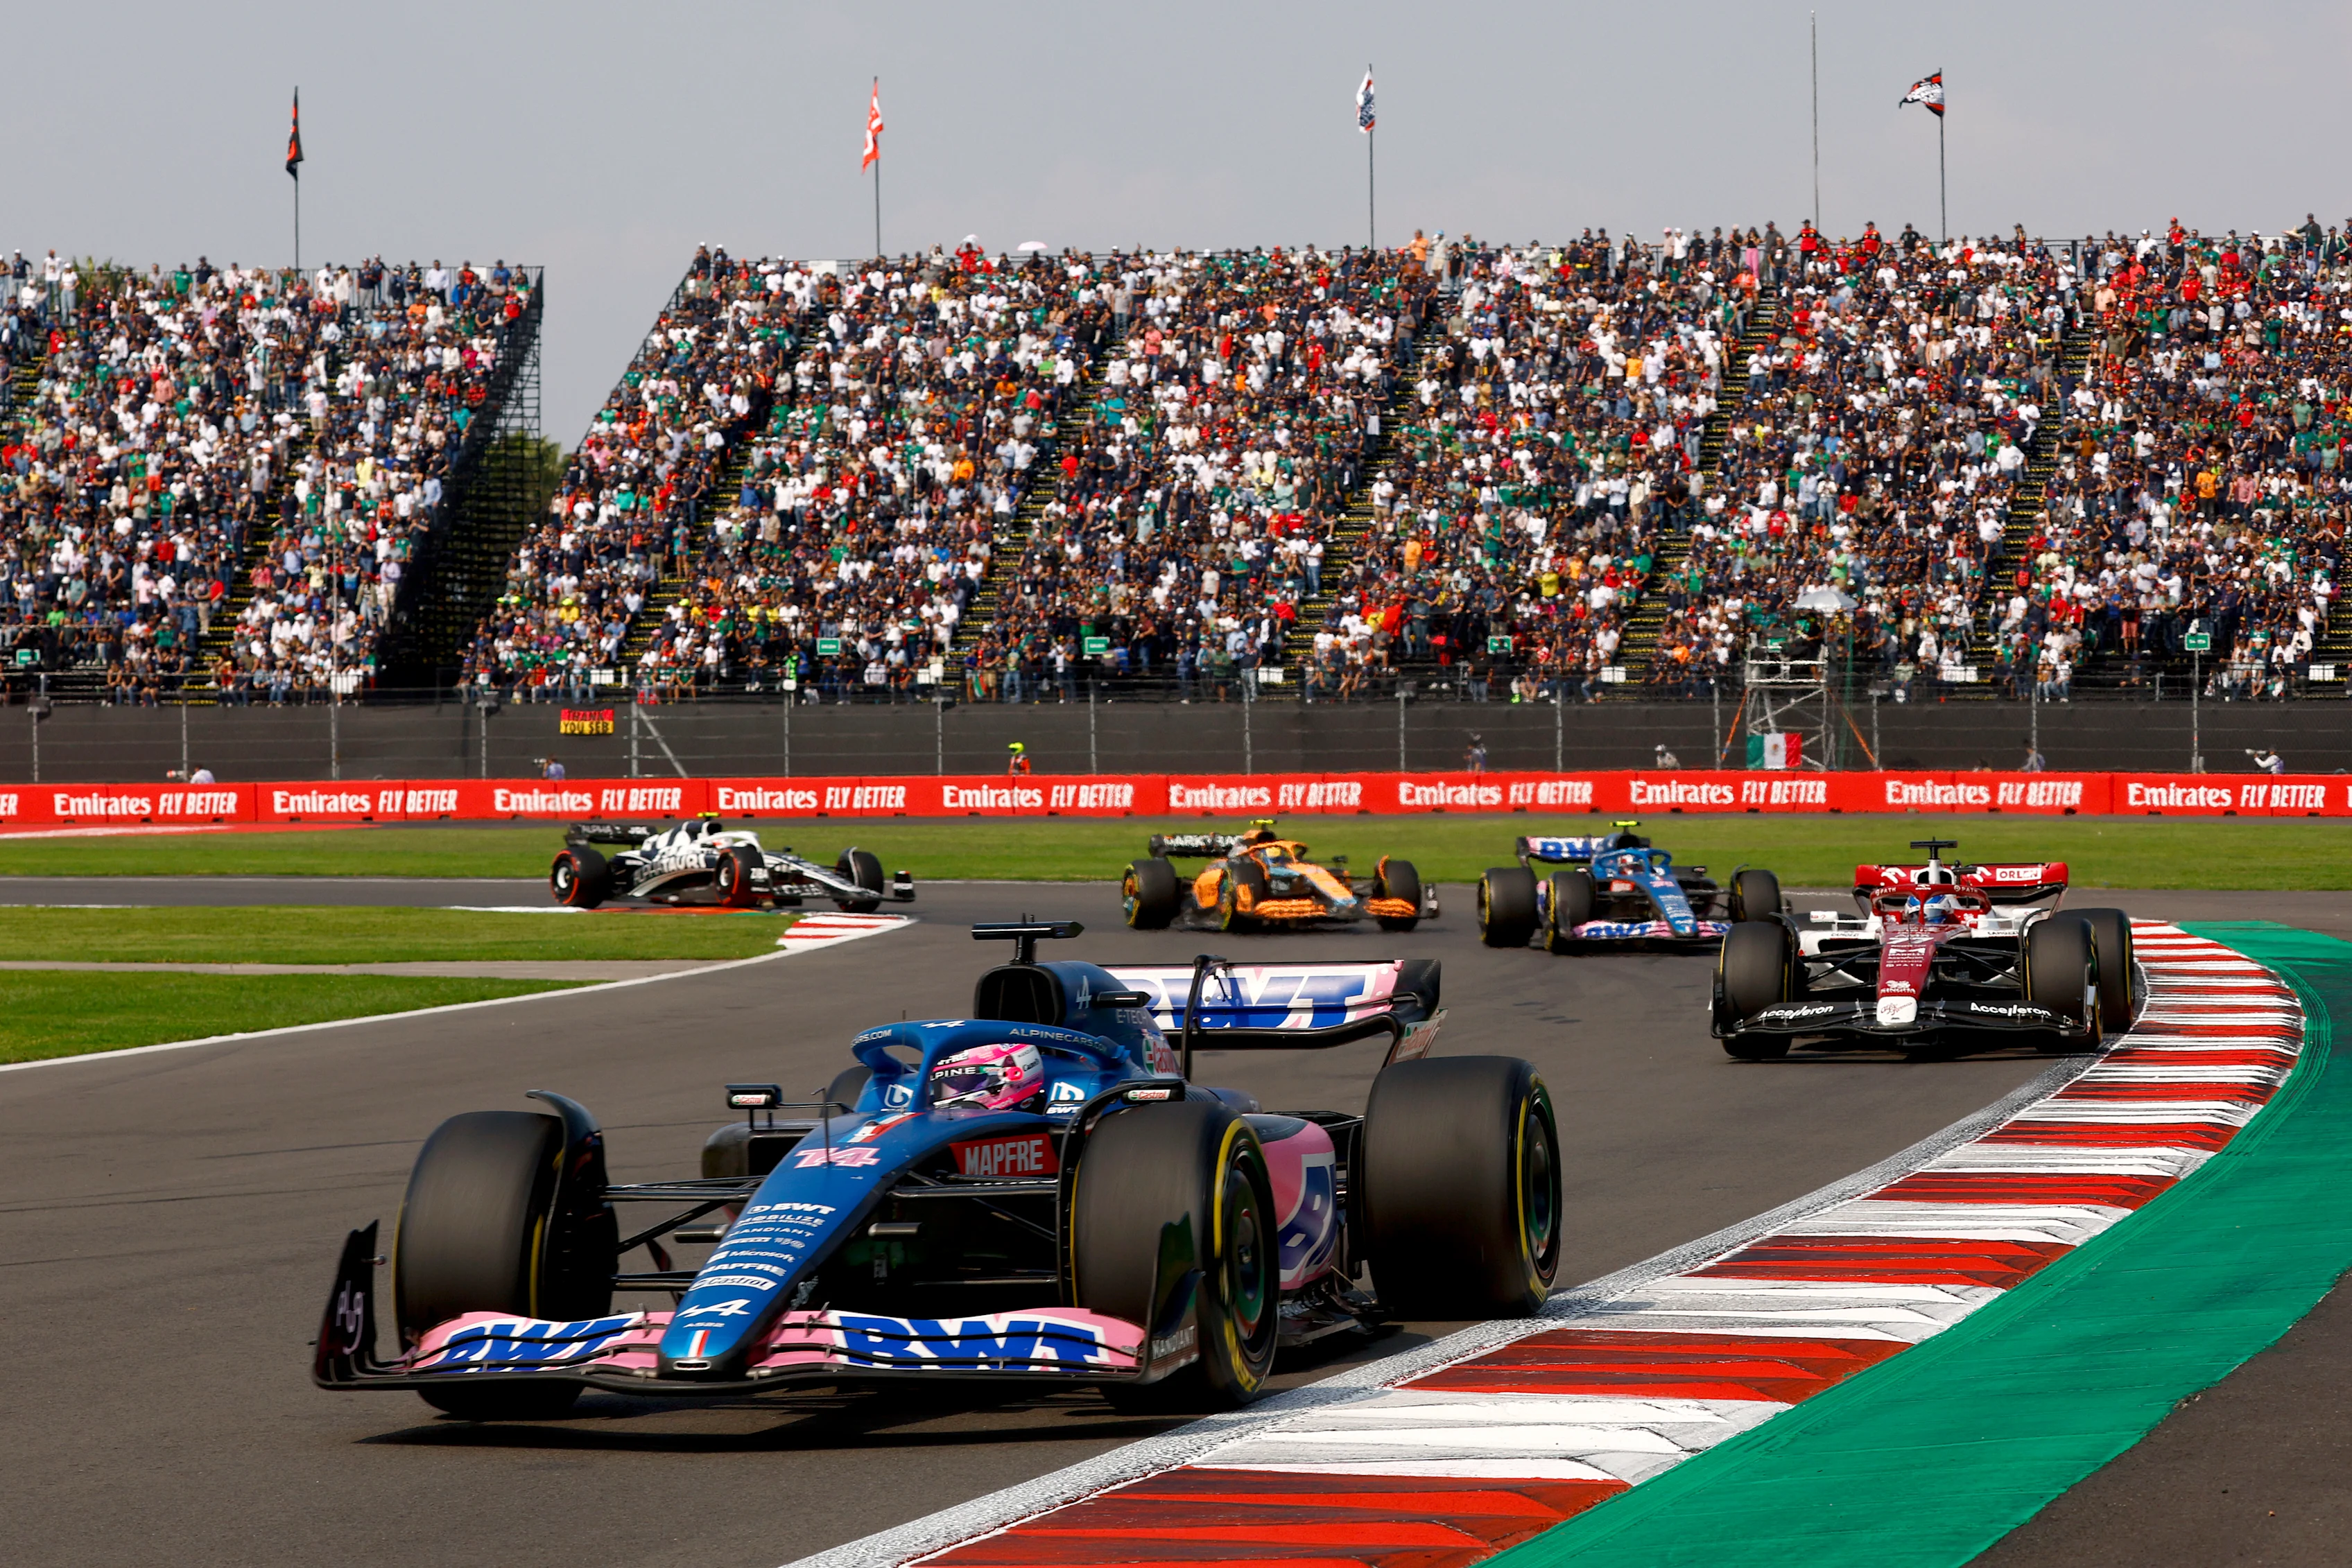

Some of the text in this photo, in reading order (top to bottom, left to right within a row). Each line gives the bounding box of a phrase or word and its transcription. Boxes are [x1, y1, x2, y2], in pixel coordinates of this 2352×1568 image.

[562, 722, 584, 733] YOU
[54, 792, 237, 815] Emirates FLY BETTER
[273, 790, 457, 812] Emirates FLY BETTER
[494, 787, 681, 811] Emirates FLY BETTER
[718, 785, 906, 809] Emirates FLY BETTER
[943, 784, 1133, 808] Emirates FLY BETTER
[1170, 782, 1362, 806] Emirates FLY BETTER
[1399, 781, 1593, 805] Emirates FLY BETTER
[1630, 780, 1826, 804] Emirates FLY BETTER
[1886, 780, 2082, 806] Emirates FLY BETTER
[2128, 783, 2231, 807] Emirates
[2240, 784, 2267, 808] FLY
[2270, 784, 2326, 808] BETTER
[929, 1066, 976, 1081] LPINE
[1138, 1090, 1168, 1100] Castrol
[965, 1139, 1043, 1175] MAPFRE
[770, 1203, 837, 1214] BWT
[728, 1250, 795, 1263] Microsoft
[697, 1262, 787, 1277] MAPFRE
[709, 1276, 769, 1288] Castrol
[839, 1316, 1100, 1372] BWT
